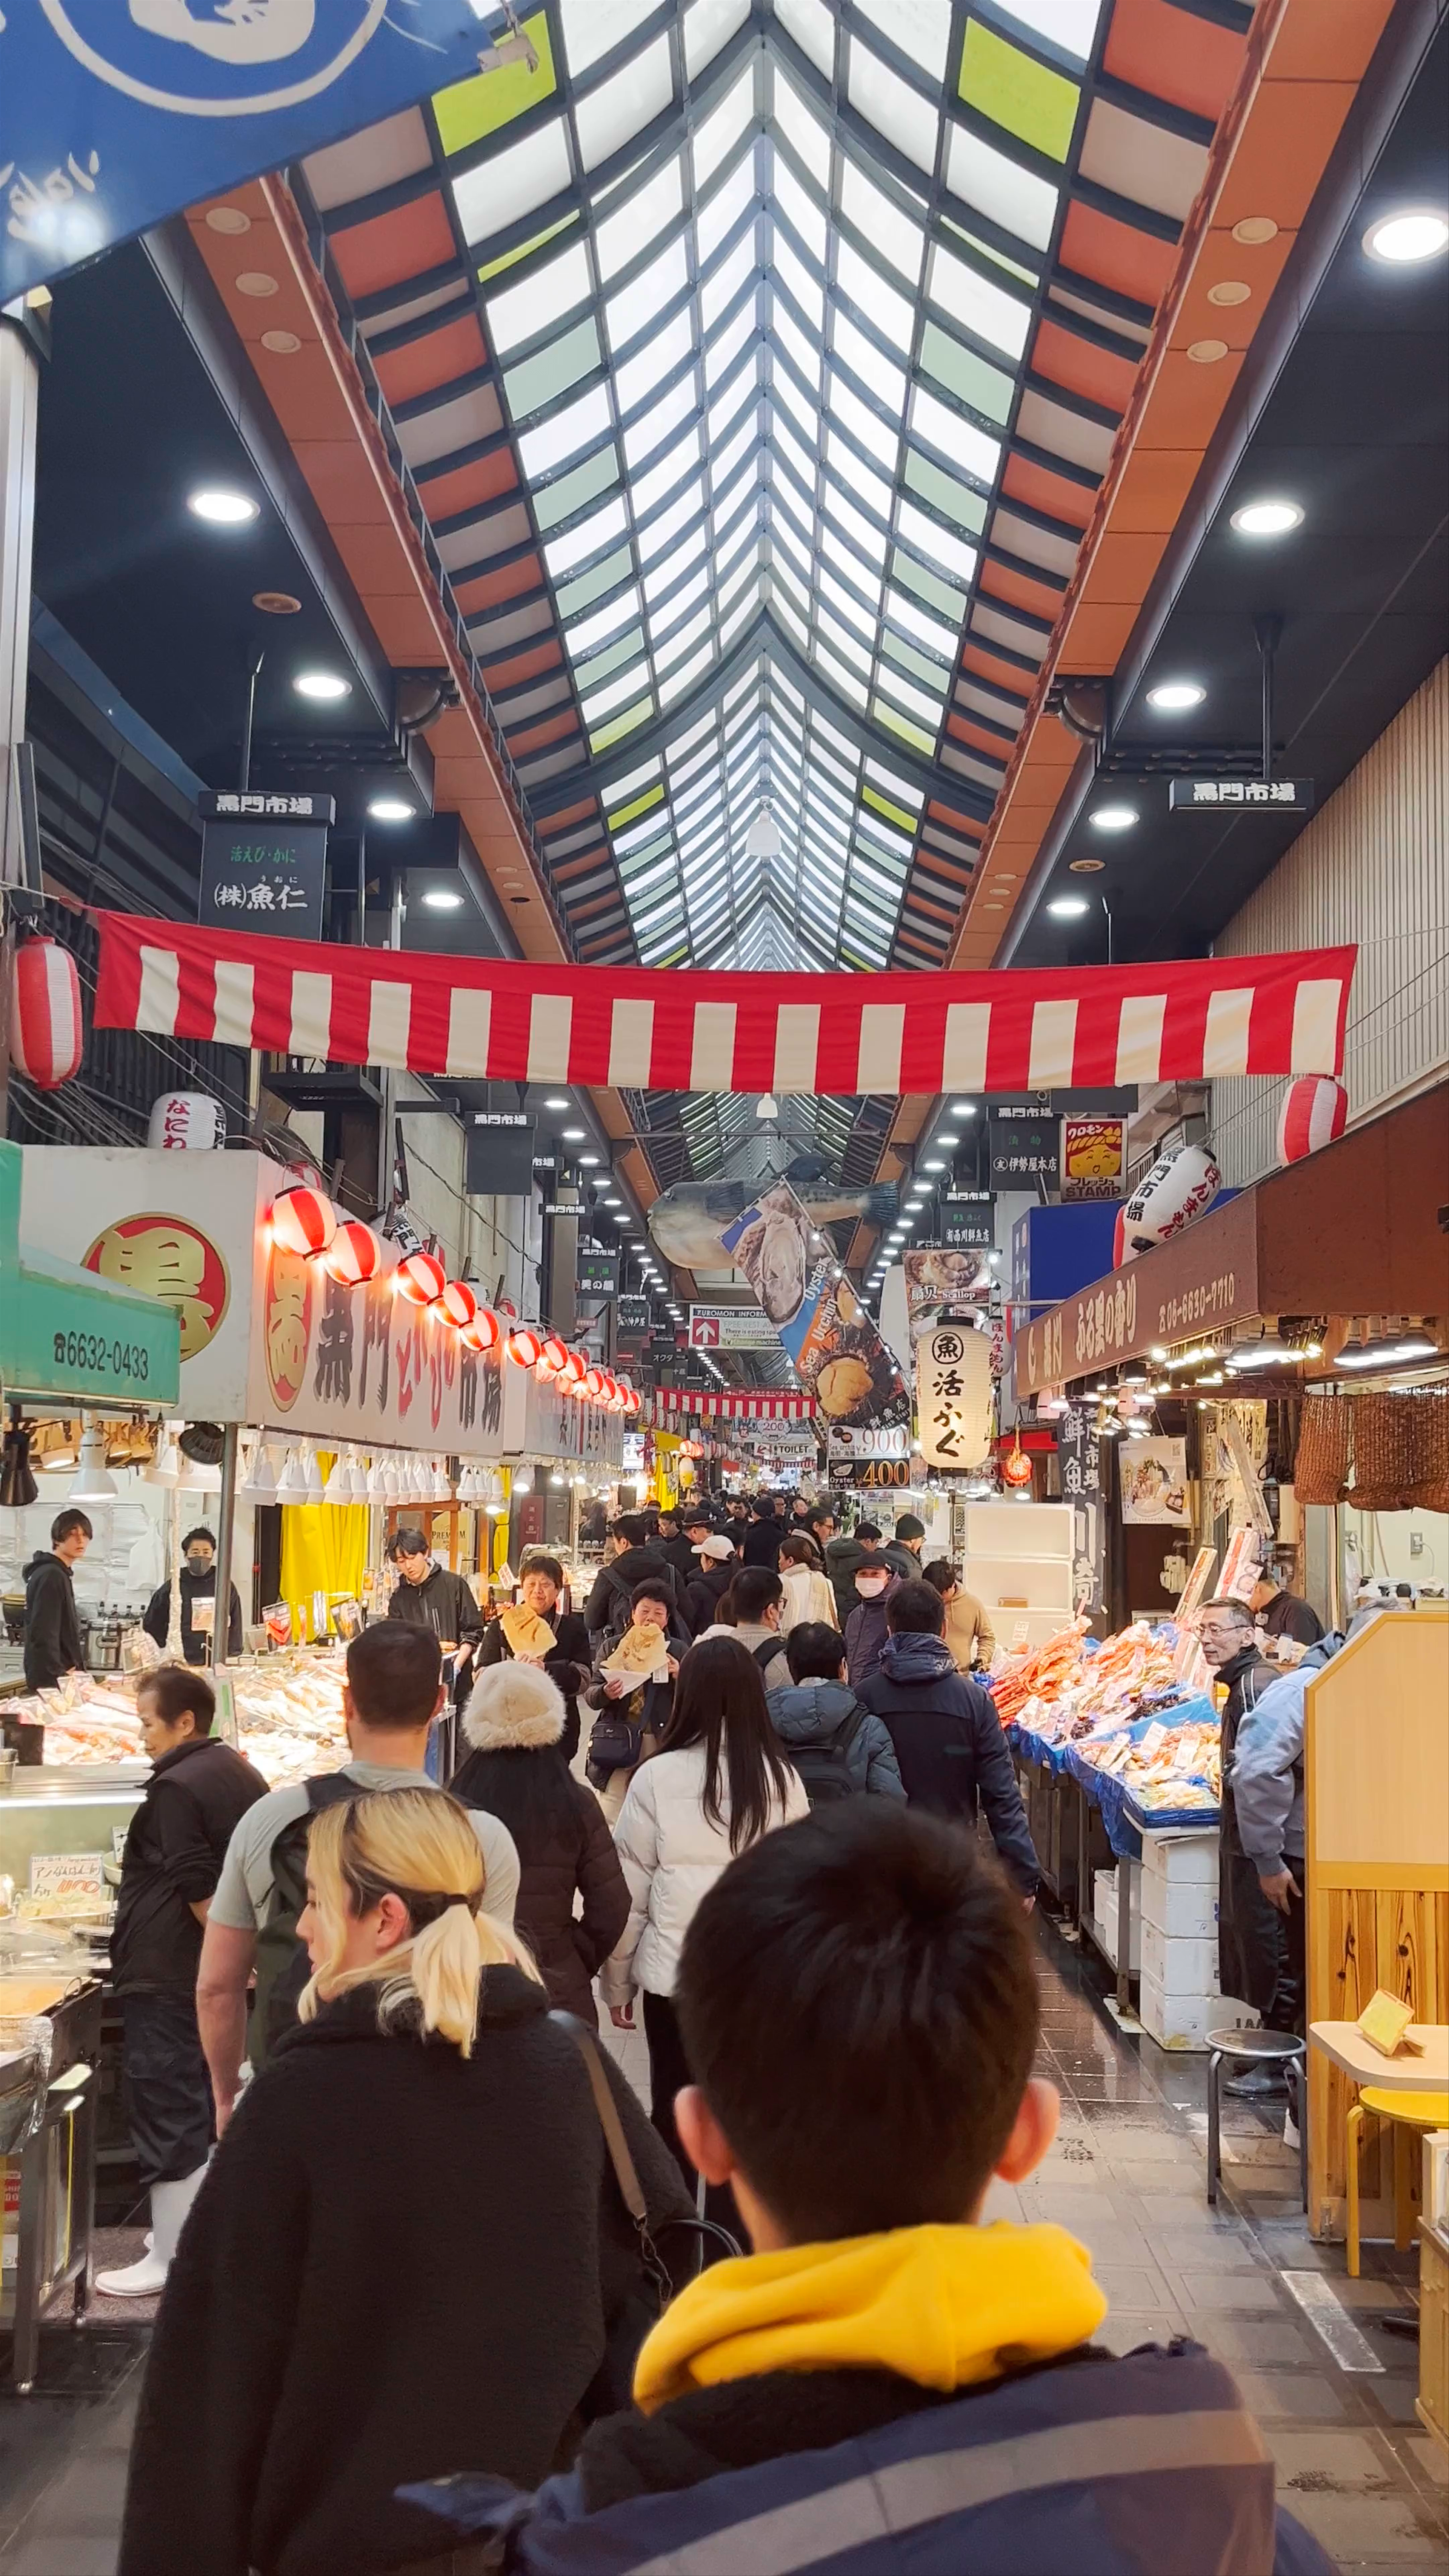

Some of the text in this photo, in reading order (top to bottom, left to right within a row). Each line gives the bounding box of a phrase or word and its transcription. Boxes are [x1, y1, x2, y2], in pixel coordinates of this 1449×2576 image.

[1193, 783, 1295, 801] 黒門市場
[217, 795, 312, 814] 黒門市場
[474, 1114, 527, 1125] 黒門市場
[998, 1107, 1053, 1118] 黒門市場
[1068, 1124, 1104, 1138] クロモン
[1070, 1177, 1115, 1186] フレッシュ
[1127, 1147, 1185, 1222] 黒門市場
[947, 1192, 990, 1201] 黒門市場
[1066, 1186, 1121, 1197] STAMP
[546, 1205, 585, 1213] 黒門市場
[804, 1258, 831, 1301] Oyster
[942, 1290, 975, 1300] Scallop
[1167, 1272, 1235, 1330] 06-6630-7710
[800, 1298, 837, 1373] Sea Urchin
[67, 1330, 148, 1381] 6632-0433
[869, 1398, 906, 1429] 鮮魚店
[932, 1370, 964, 1457] 活ふぐ
